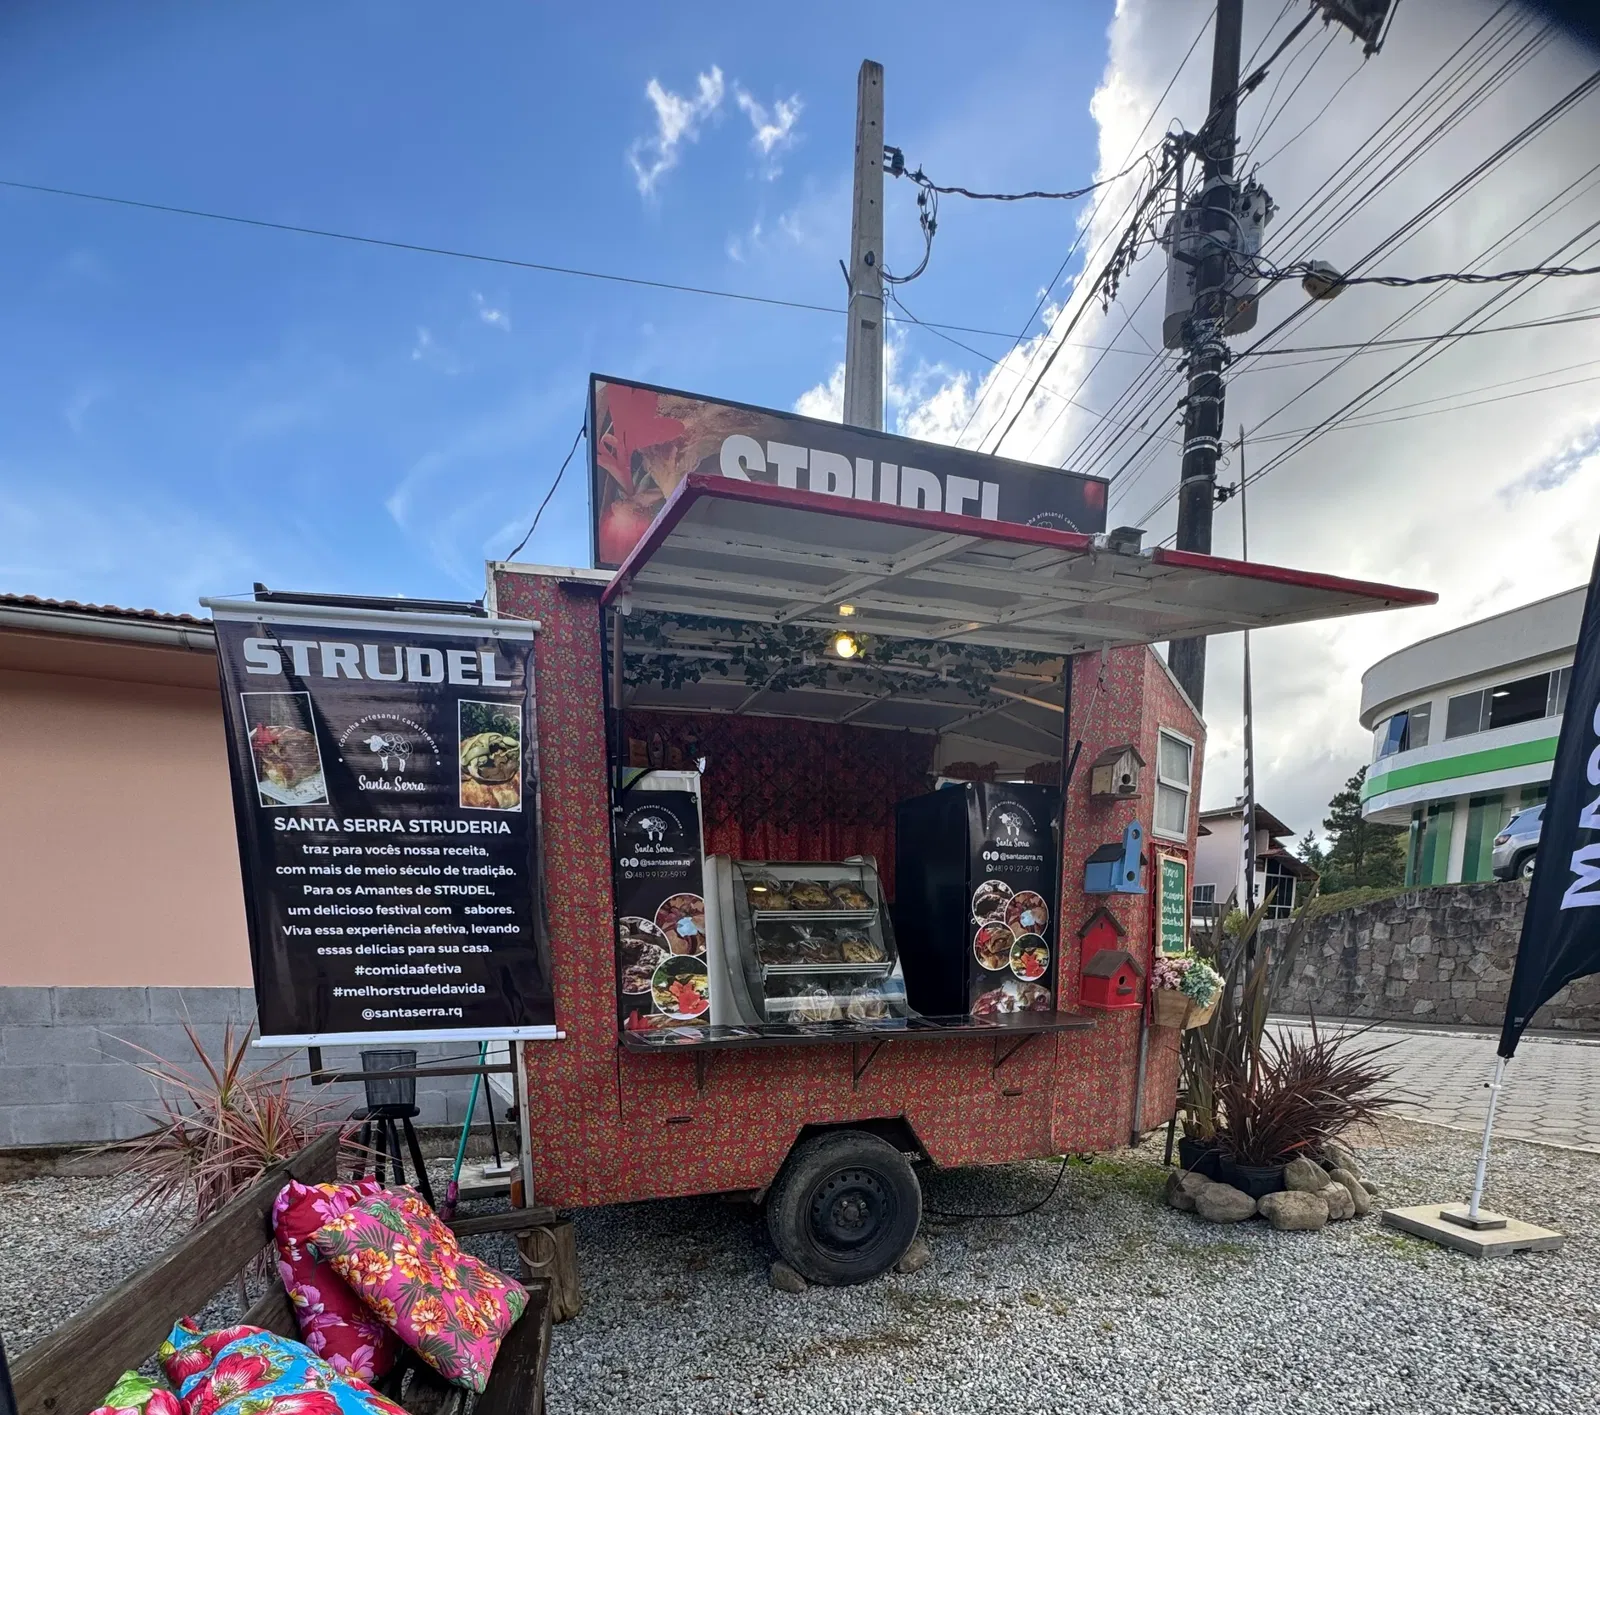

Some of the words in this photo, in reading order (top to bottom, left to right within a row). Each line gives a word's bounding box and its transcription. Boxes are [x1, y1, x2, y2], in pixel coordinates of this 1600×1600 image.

[242, 637, 513, 687] STRUDEL
[339, 721, 360, 747] cozinha
[360, 712, 400, 724] artesanal
[402, 716, 440, 754] catarinense
[358, 774, 393, 791] Santa
[394, 775, 426, 792] Serra
[274, 816, 340, 833] SANTA
[343, 818, 406, 833] SERRA
[408, 819, 512, 834] STRUDERIA
[302, 844, 330, 855] traz
[332, 846, 363, 857] para
[364, 844, 401, 855] vocês
[403, 847, 441, 856] nossa
[443, 844, 490, 857] receita,
[635, 843, 654, 853] Santa
[640, 859, 691, 867] @santaserra.rq
[1000, 853, 1044, 862] @santaserra.rq
[275, 866, 306, 875] com
[308, 863, 342, 876] mais
[344, 864, 363, 876] de
[364, 864, 398, 875] meio
[399, 864, 441, 876] século
[443, 865, 460, 876] de
[461, 864, 517, 878] tradição.
[303, 884, 334, 895] Para
[336, 886, 352, 895] os
[354, 885, 413, 895] Amantes
[415, 884, 432, 895] de
[434, 885, 496, 896] STRUDEL,
[287, 907, 311, 916] um
[313, 904, 374, 916] delicioso
[375, 904, 422, 915] festival
[424, 906, 452, 915] com
[464, 904, 515, 915] sabores.
[282, 924, 312, 936] Viva
[314, 927, 344, 935] essa
[346, 923, 422, 937] experiência
[423, 923, 469, 935] afetiva,
[471, 923, 520, 934] levando
[317, 946, 353, 955] essas
[355, 943, 405, 955] delícias
[407, 945, 436, 956] para
[437, 945, 460, 954] sua
[461, 944, 493, 953] casa.
[354, 963, 462, 976] #comidaafetiva
[332, 982, 486, 997] #melhorstrudeldavida
[361, 1007, 463, 1021] @santaserra.rq
